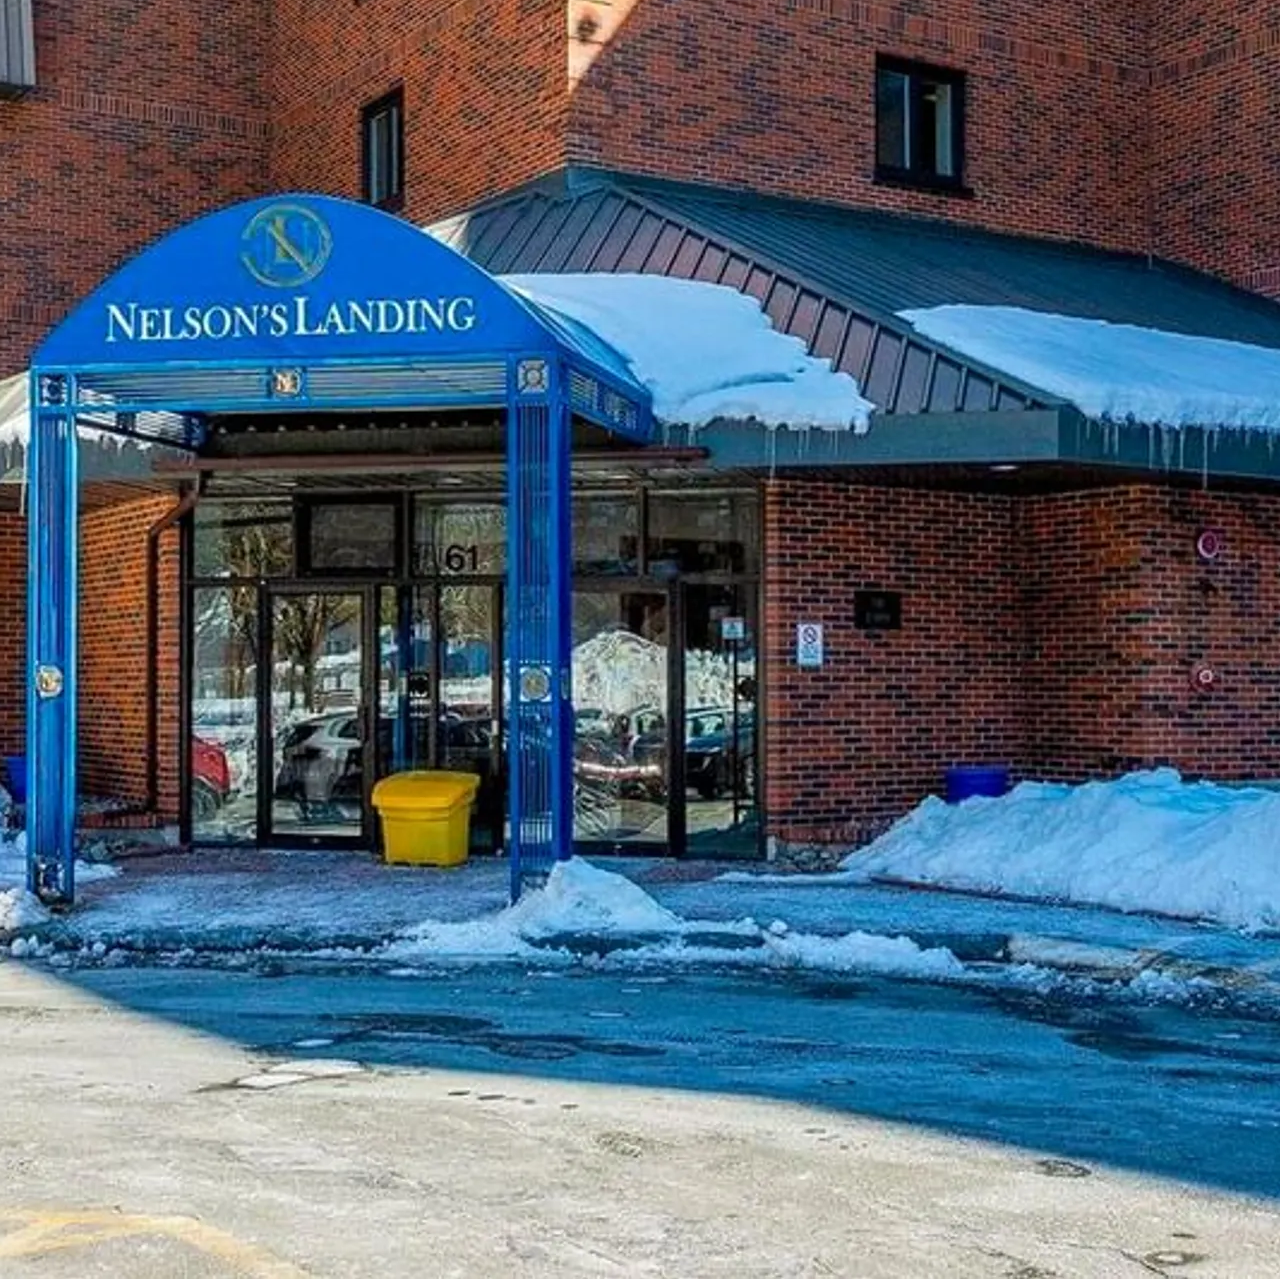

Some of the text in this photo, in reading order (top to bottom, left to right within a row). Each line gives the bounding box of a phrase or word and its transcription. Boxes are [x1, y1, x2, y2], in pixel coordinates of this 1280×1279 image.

[104, 295, 476, 343] NELSON'S LANDING
[446, 545, 478, 571] 61
